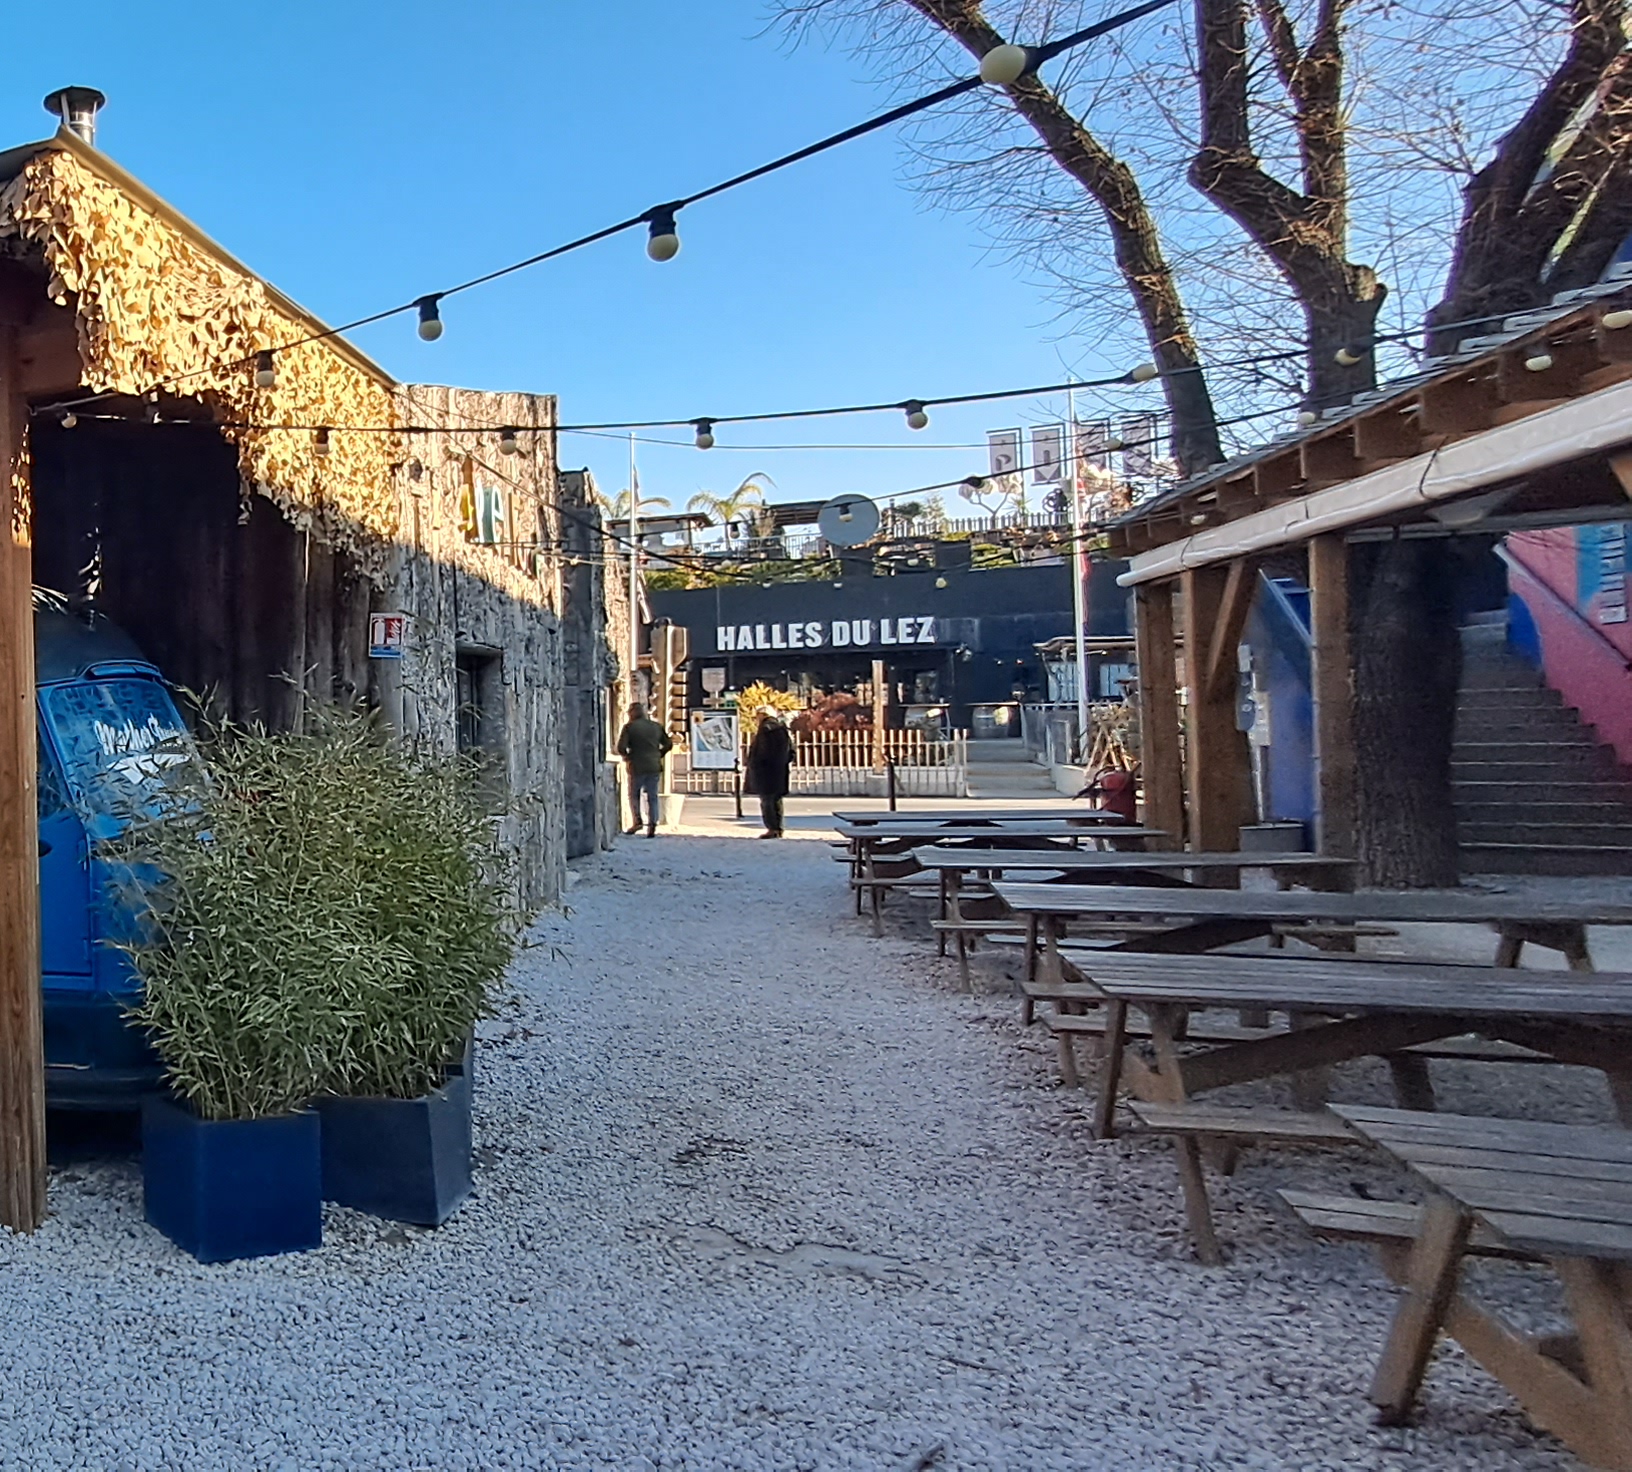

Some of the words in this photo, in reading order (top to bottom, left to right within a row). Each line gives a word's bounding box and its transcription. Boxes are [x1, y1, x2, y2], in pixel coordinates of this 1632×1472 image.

[717, 621, 822, 650] HALLES
[831, 619, 871, 647] DU
[880, 616, 935, 645] LEZ
